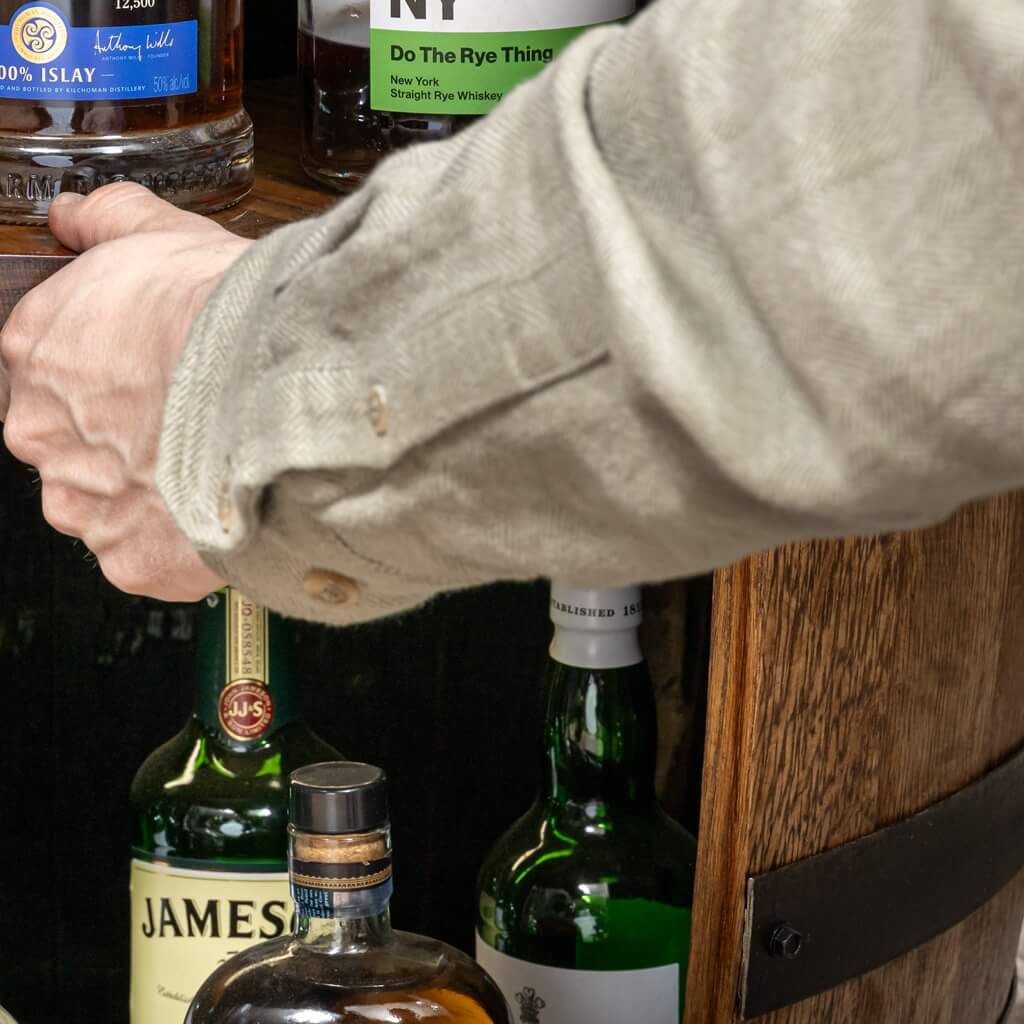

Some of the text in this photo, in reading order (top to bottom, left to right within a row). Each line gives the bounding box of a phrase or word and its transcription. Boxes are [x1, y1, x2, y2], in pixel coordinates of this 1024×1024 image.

[390, 45, 553, 66] Do The Rye Thing
[41, 67, 95, 83] ISLAY
[390, 75, 439, 87] New York
[390, 88, 502, 101] Straight Rye Whiskey
